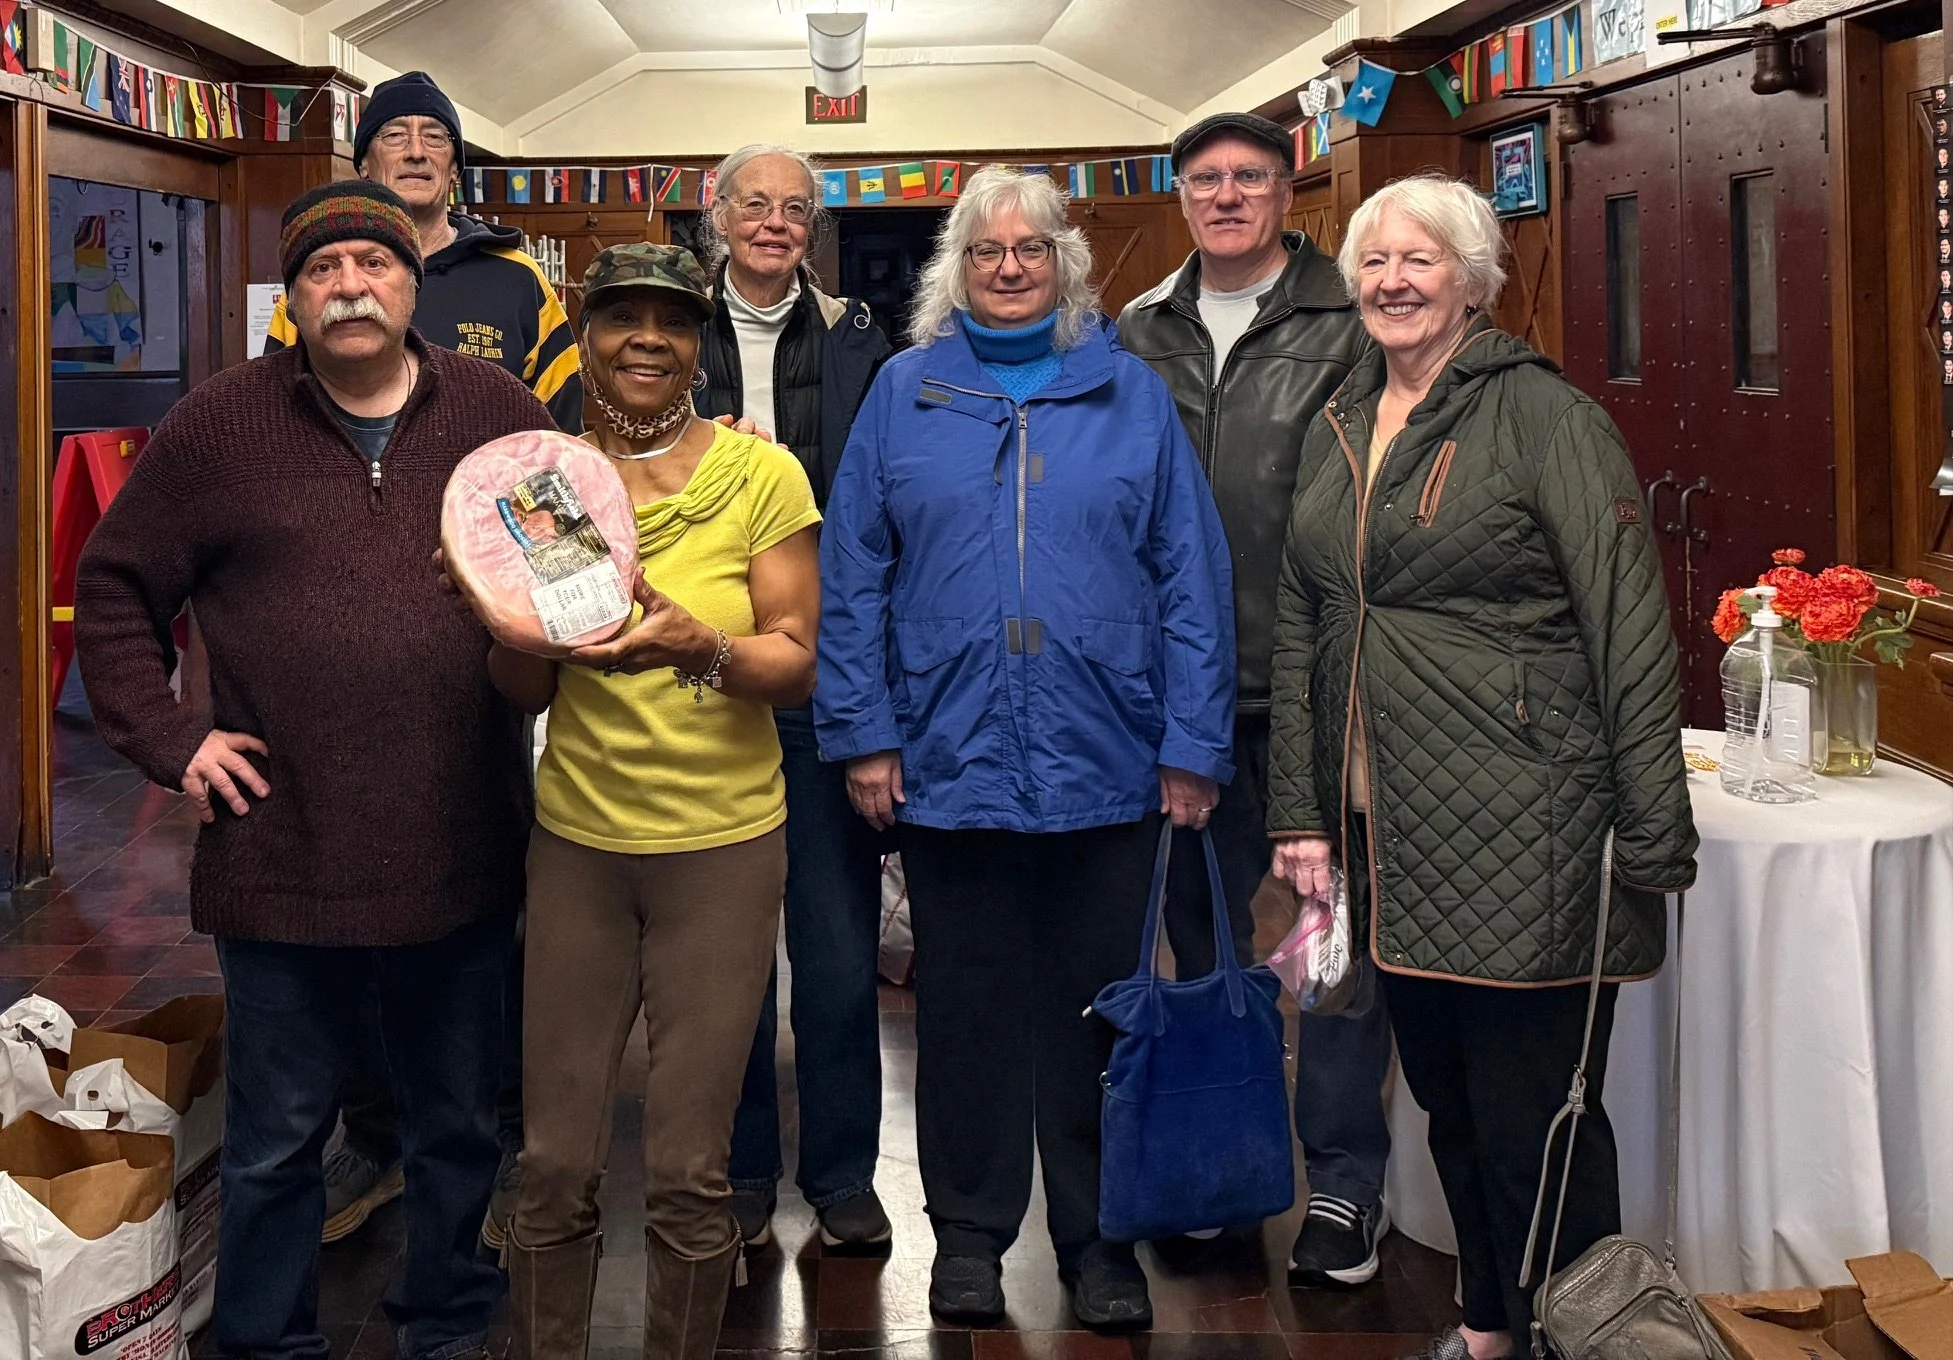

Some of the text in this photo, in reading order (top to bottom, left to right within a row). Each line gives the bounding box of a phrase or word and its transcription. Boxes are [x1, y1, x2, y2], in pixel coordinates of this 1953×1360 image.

[813, 92, 860, 117] EXIT
[457, 323, 474, 333] POLO
[475, 323, 494, 337] JEANS
[467, 334, 481, 343] EST.
[457, 342, 503, 358] RALPH LAUREN
[550, 474, 581, 520] Smithfield
[554, 589, 567, 611] DOLLAR
[563, 589, 572, 605] YOUR
[570, 589, 578, 600] FOR
[576, 584, 586, 600] MORE
[88, 1316, 136, 1349] SUPER
